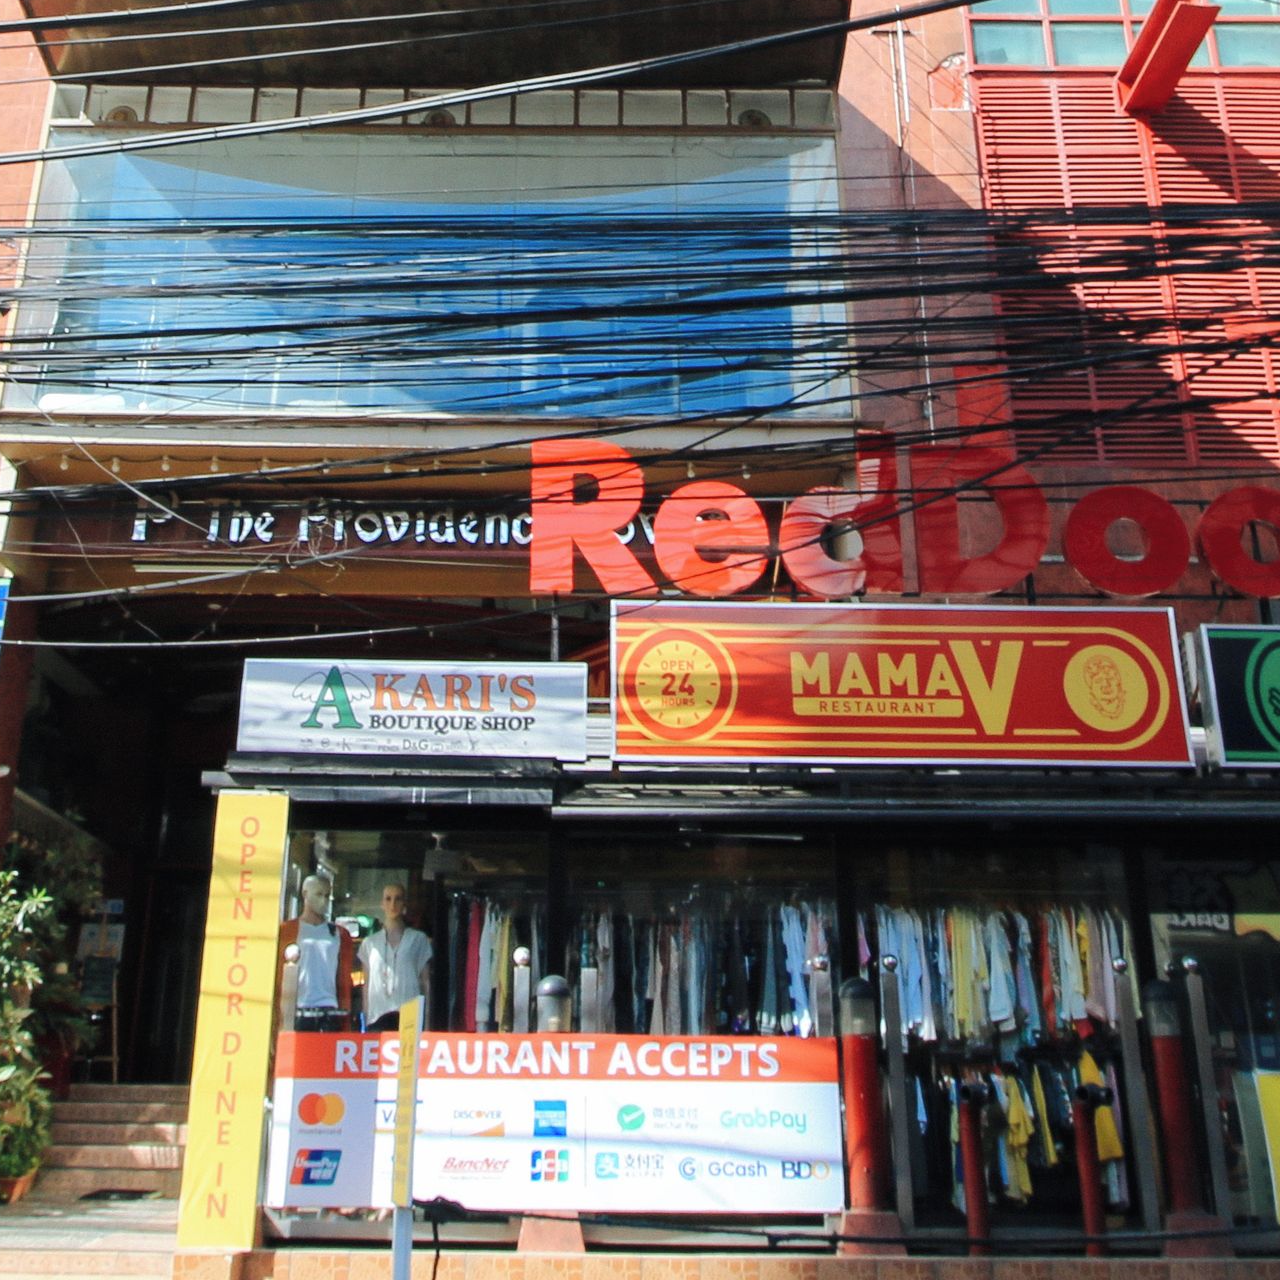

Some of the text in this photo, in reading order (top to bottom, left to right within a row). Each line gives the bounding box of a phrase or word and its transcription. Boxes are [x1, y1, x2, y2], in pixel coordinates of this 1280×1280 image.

[298, 496, 532, 545] Providenc
[661, 660, 695, 672] OPEN
[661, 673, 695, 697] 24
[790, 640, 1025, 736] MAMA V
[661, 697, 696, 708] HOURS
[819, 701, 937, 715] RESTAURANT
[369, 715, 535, 734] BOUTIQUE SHOP
[206, 816, 260, 1219] OPEN FOR DINE IN
[607, 1042, 781, 1077] ACCEPTS
[720, 1108, 807, 1133] GrabPay
[443, 1156, 510, 1170] BancNet
[708, 1160, 768, 1177] GCash
[781, 1160, 830, 1180] BDO
